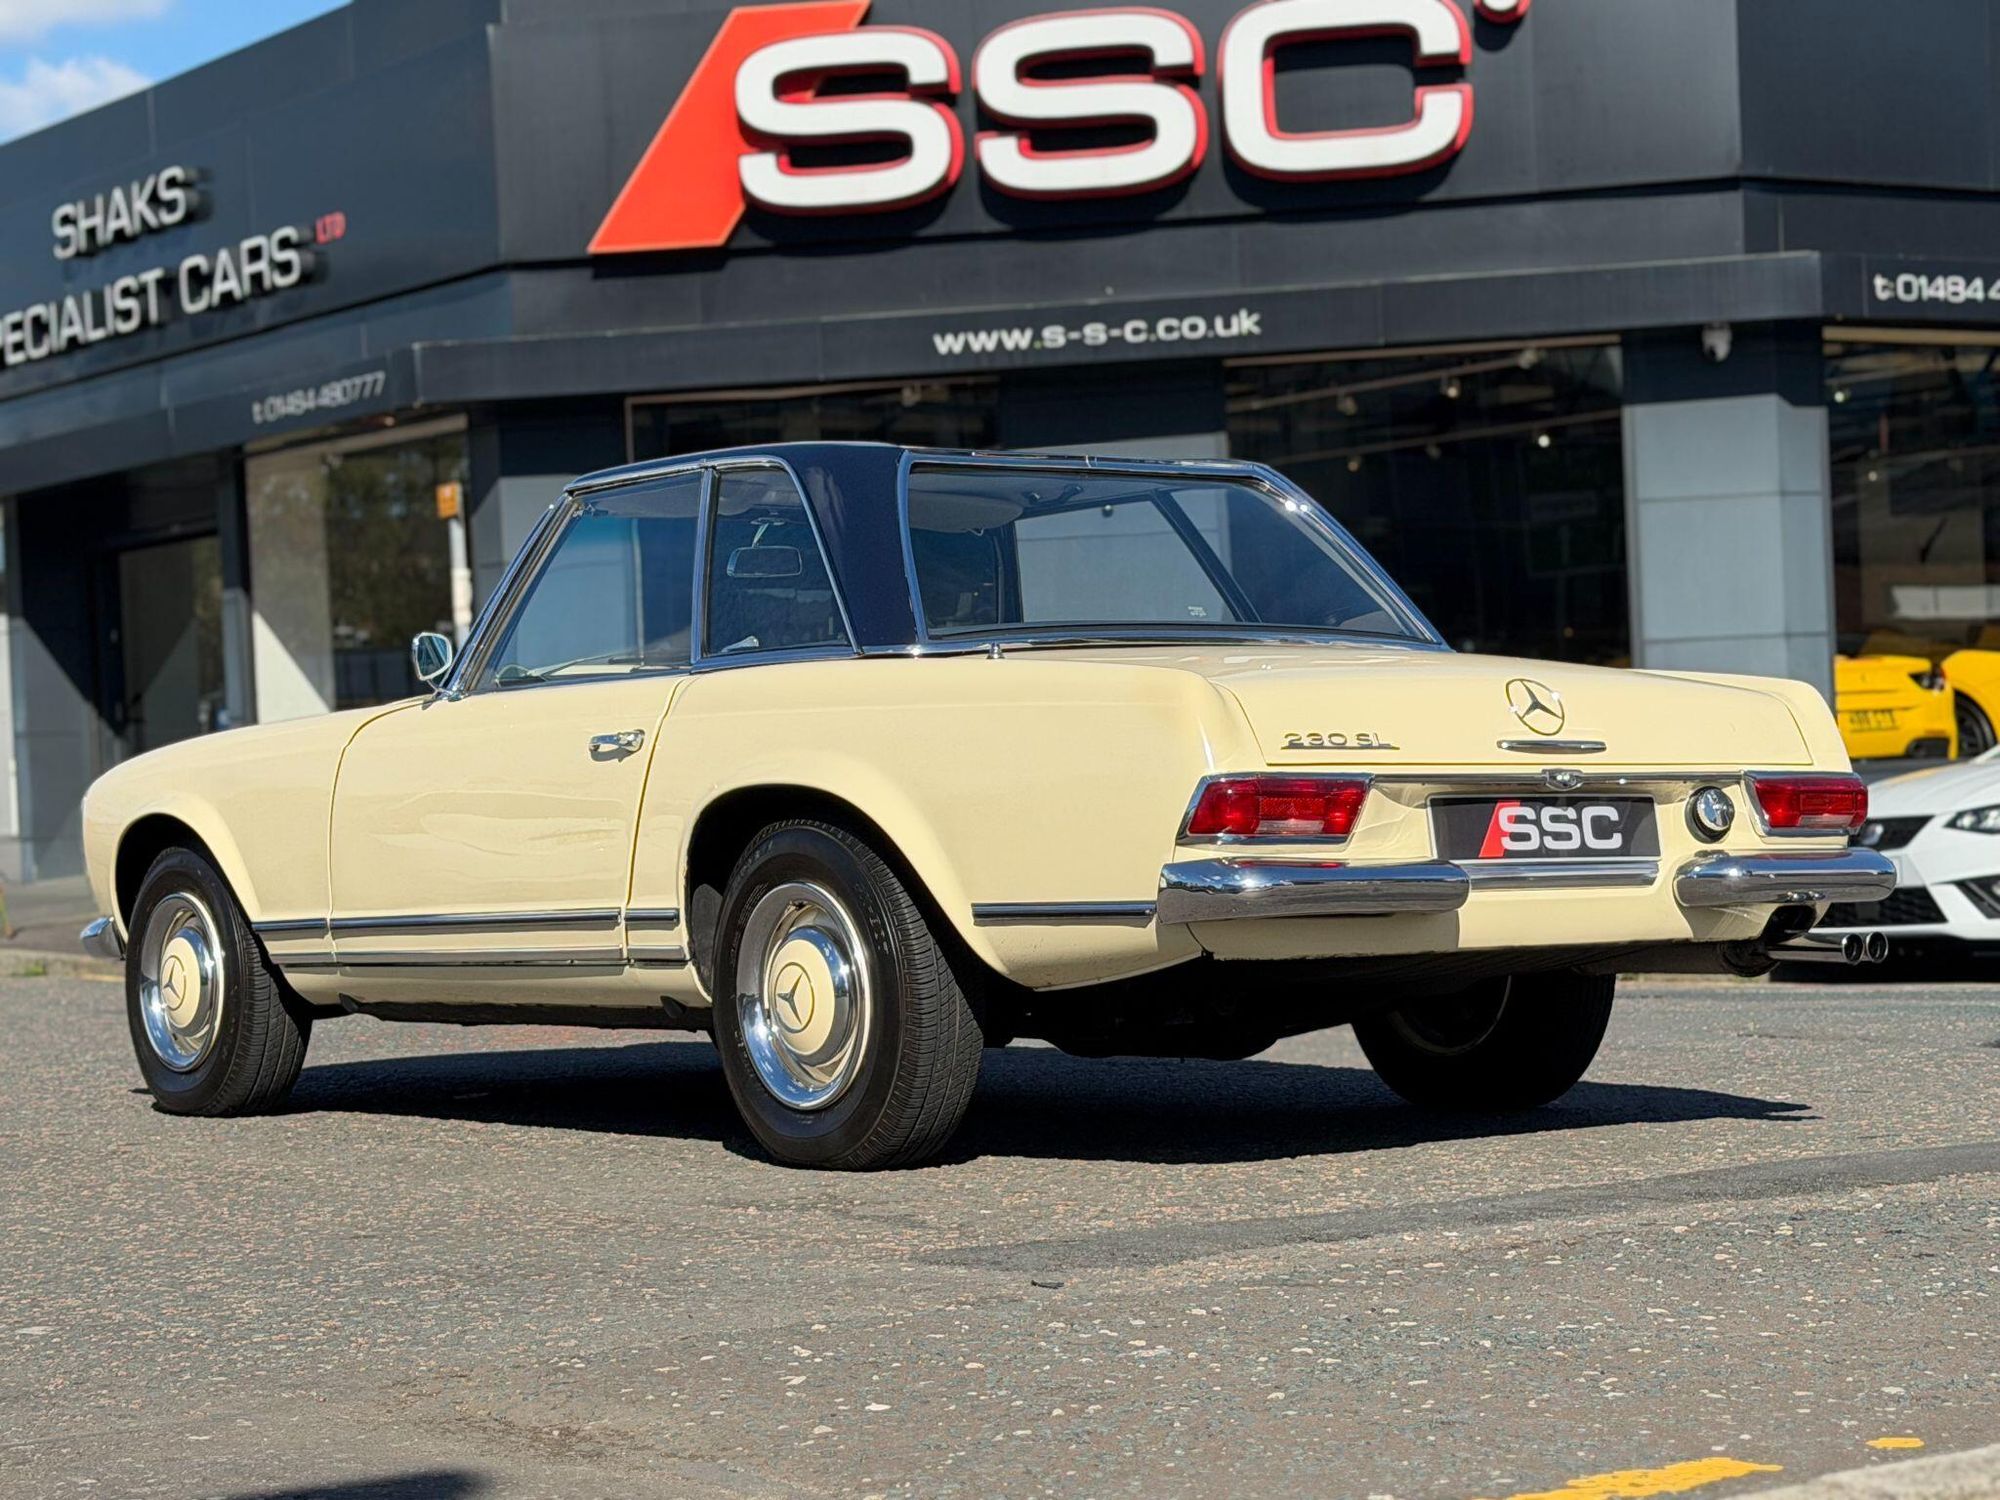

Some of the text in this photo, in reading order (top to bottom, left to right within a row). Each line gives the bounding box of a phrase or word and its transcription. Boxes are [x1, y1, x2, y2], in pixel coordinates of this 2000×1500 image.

[733, 0, 1473, 214] SSC
[52, 165, 187, 260] SHAKS
[0, 211, 346, 367] ECIALIST CARS LTD
[933, 308, 1262, 355] www.s-s-c.co.uk
[1283, 732, 1392, 748] 230 SL
[1498, 806, 1623, 850] SSC
